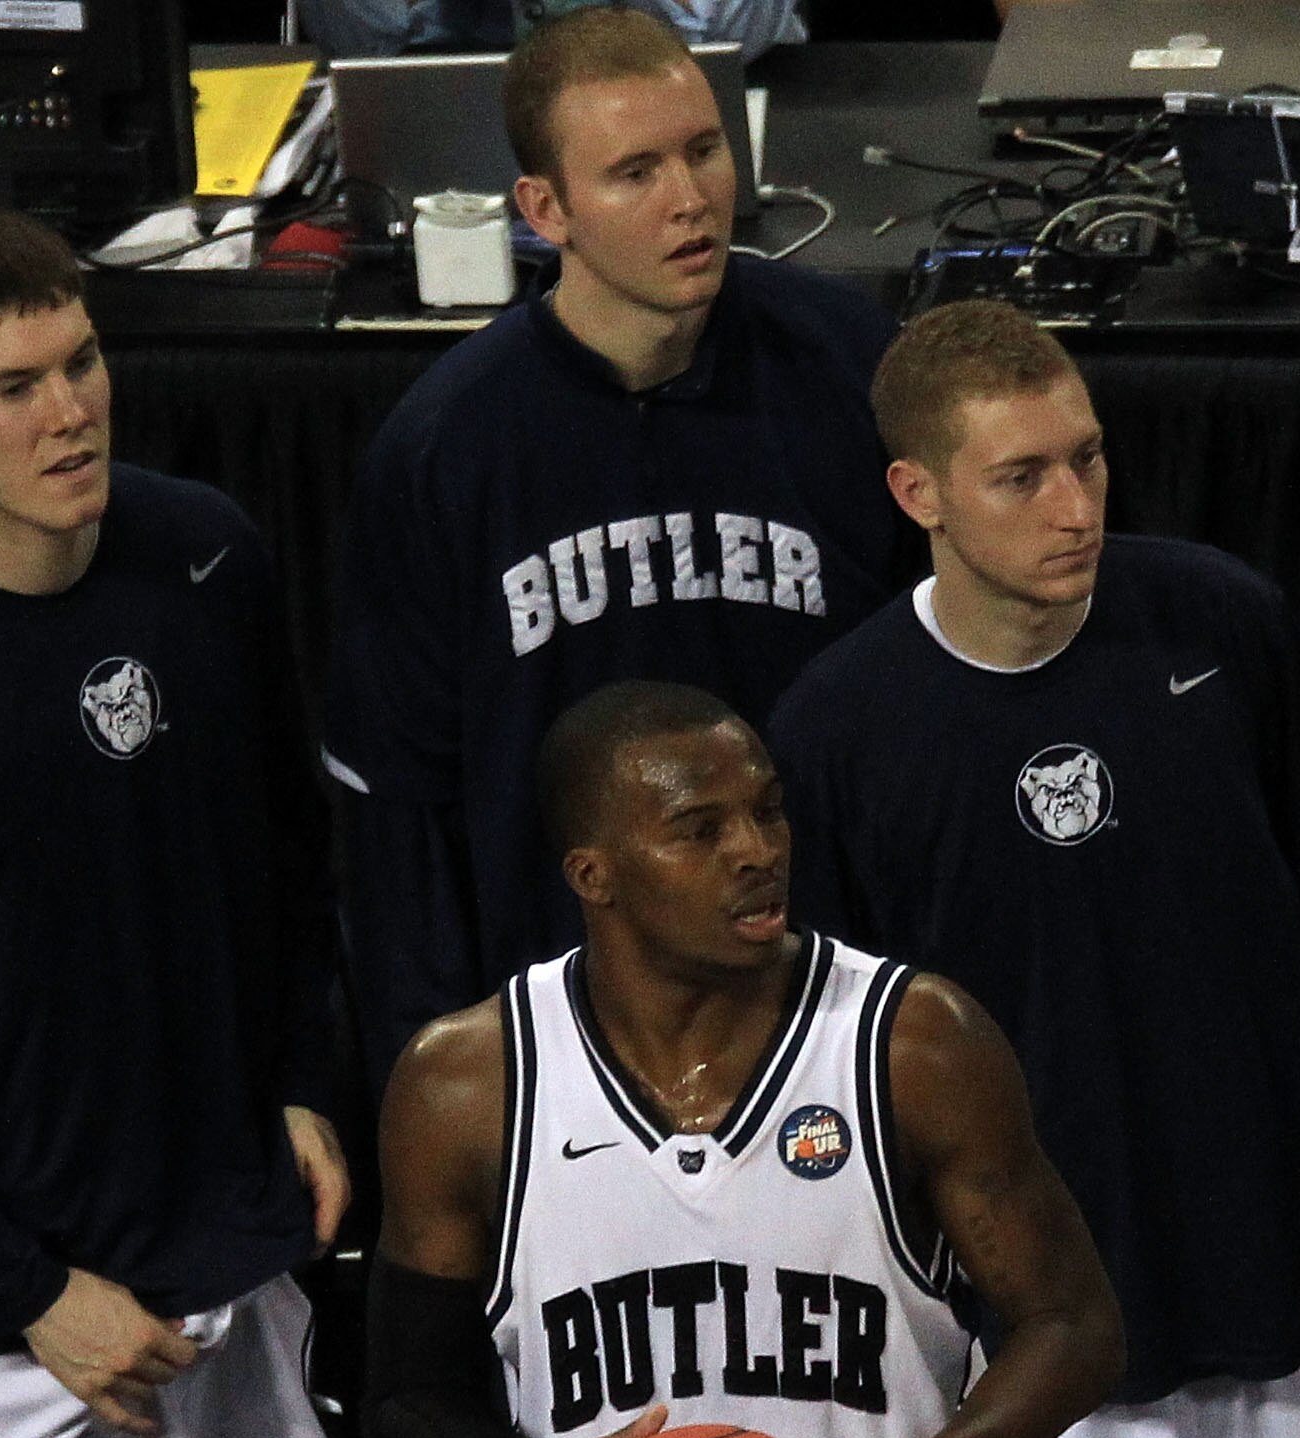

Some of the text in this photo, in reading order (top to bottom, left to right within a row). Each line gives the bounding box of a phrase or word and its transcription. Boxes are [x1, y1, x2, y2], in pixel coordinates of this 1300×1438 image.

[502, 512, 827, 658] BUTLER
[798, 1120, 839, 1140] FINAL
[541, 1260, 887, 1433] BUTLER
